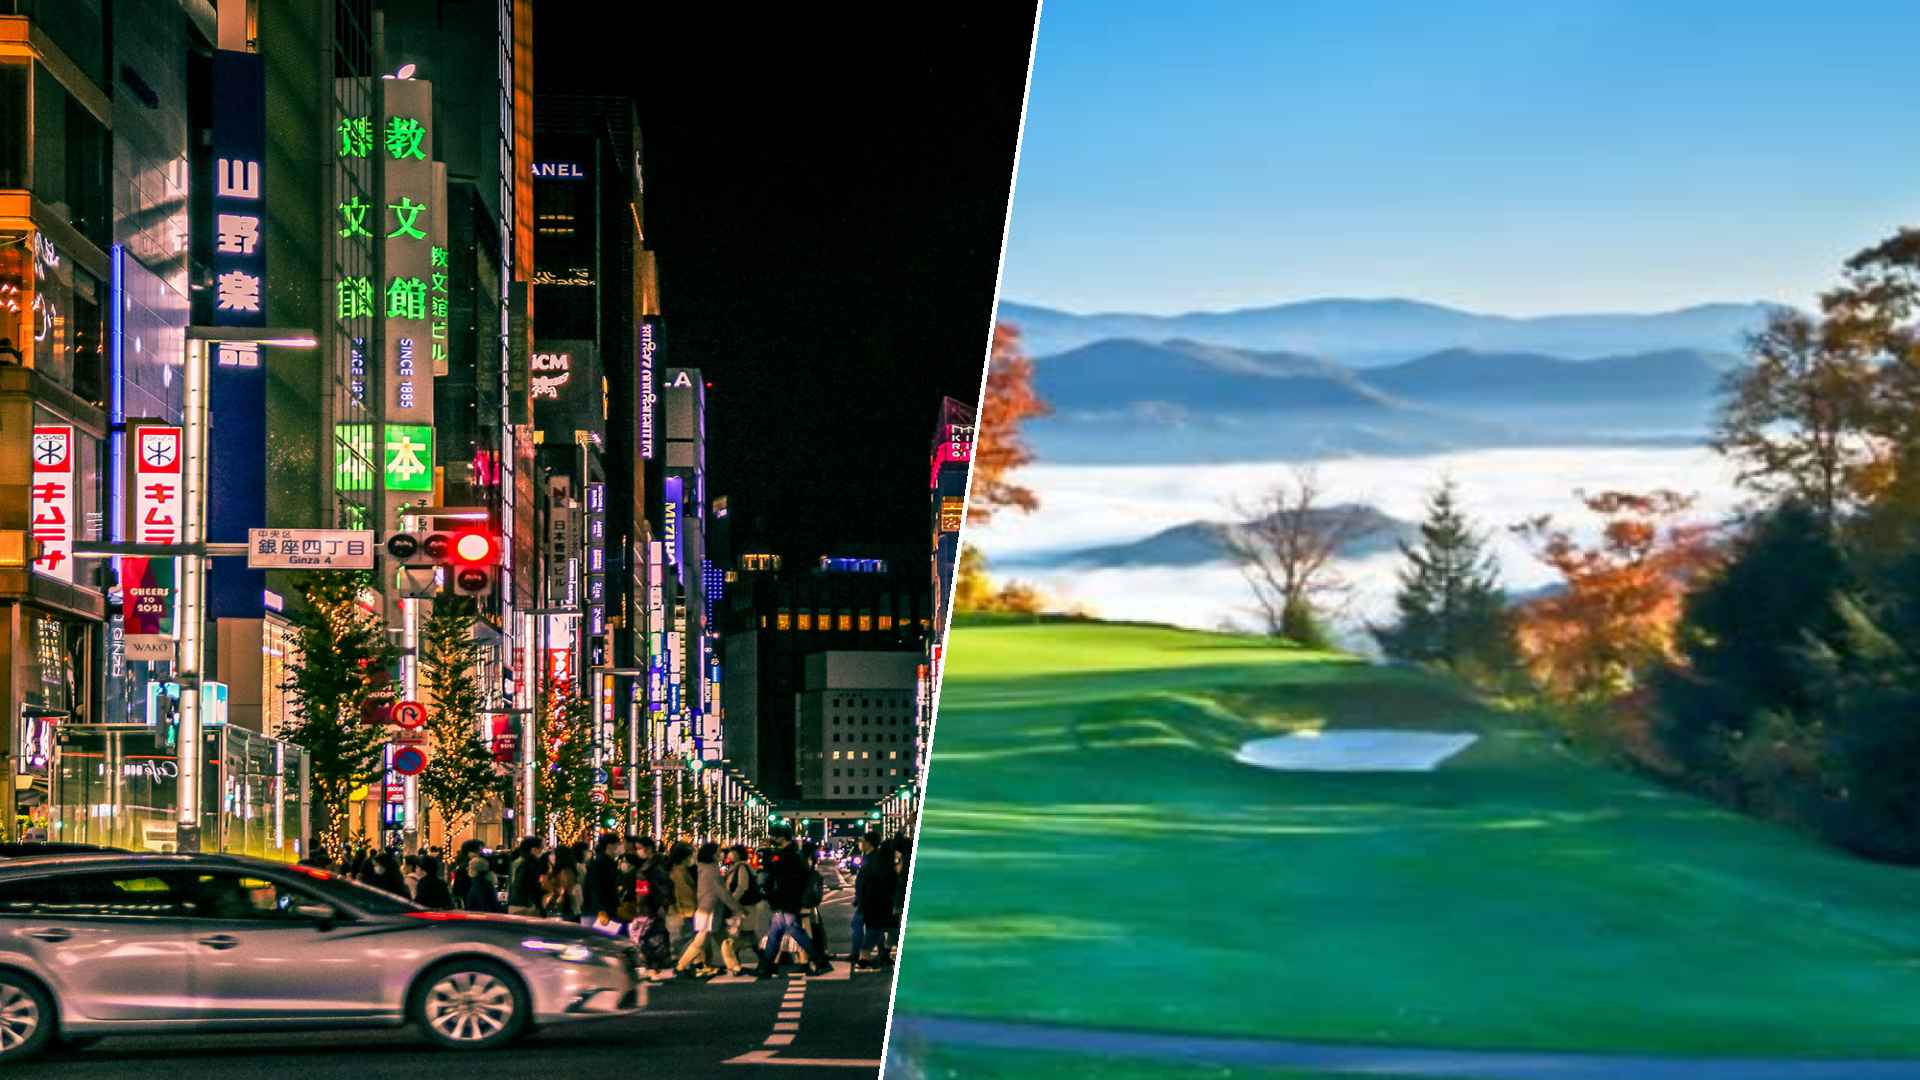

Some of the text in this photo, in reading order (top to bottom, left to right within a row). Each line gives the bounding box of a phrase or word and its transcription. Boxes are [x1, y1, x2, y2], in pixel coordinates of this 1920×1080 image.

[384, 116, 428, 320] 教文館
[400, 338, 413, 408] SINCE 1885
[386, 435, 427, 481] 本
[258, 539, 364, 555] 銀座四丁目
[289, 556, 320, 564] Ginza
[130, 588, 169, 596] CHEERS
[137, 604, 162, 612] 2021
[134, 643, 168, 651] WAKO
